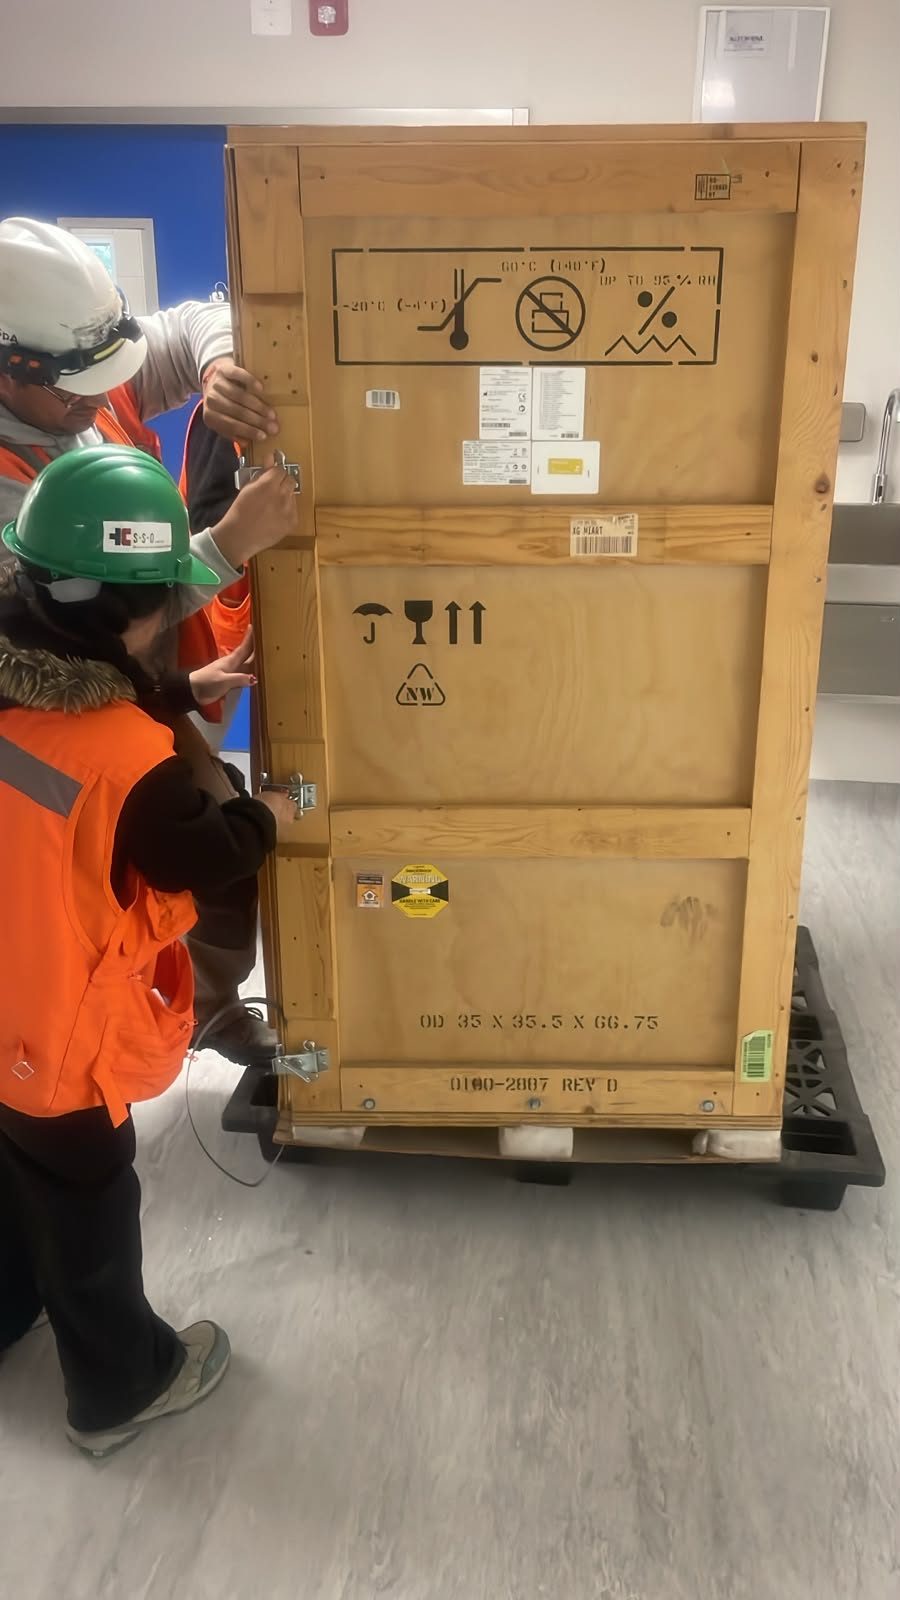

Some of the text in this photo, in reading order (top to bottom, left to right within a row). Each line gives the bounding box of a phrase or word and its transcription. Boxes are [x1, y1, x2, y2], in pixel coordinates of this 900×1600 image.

[600, 275, 617, 286] UP
[627, 275, 644, 286] TO
[698, 274, 716, 286] RH
[420, 1014, 659, 1030] OD 35 X 35.5 X 66.75
[562, 1077, 595, 1092] REV
[607, 1078, 618, 1092] D
